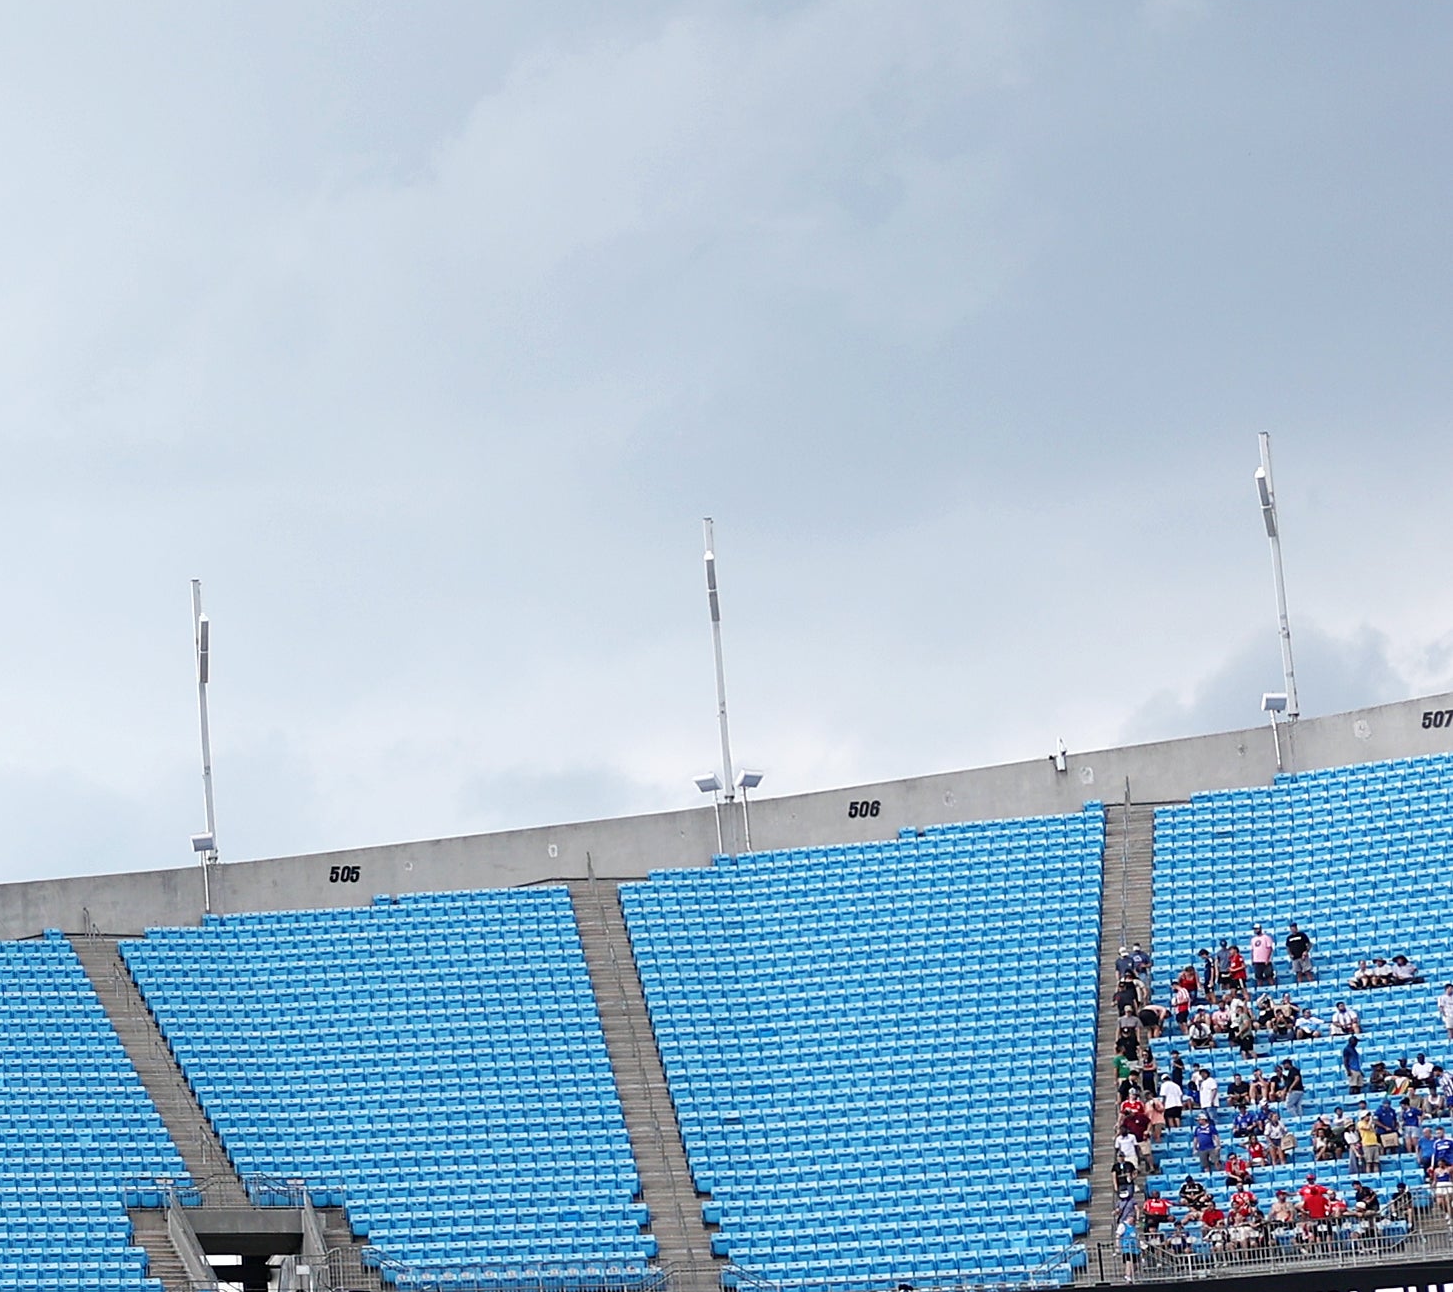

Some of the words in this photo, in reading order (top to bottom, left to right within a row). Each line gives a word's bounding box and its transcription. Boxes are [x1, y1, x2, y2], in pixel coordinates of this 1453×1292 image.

[1422, 710, 1453, 729] 507
[848, 801, 880, 818] 506
[330, 866, 360, 883] 505
